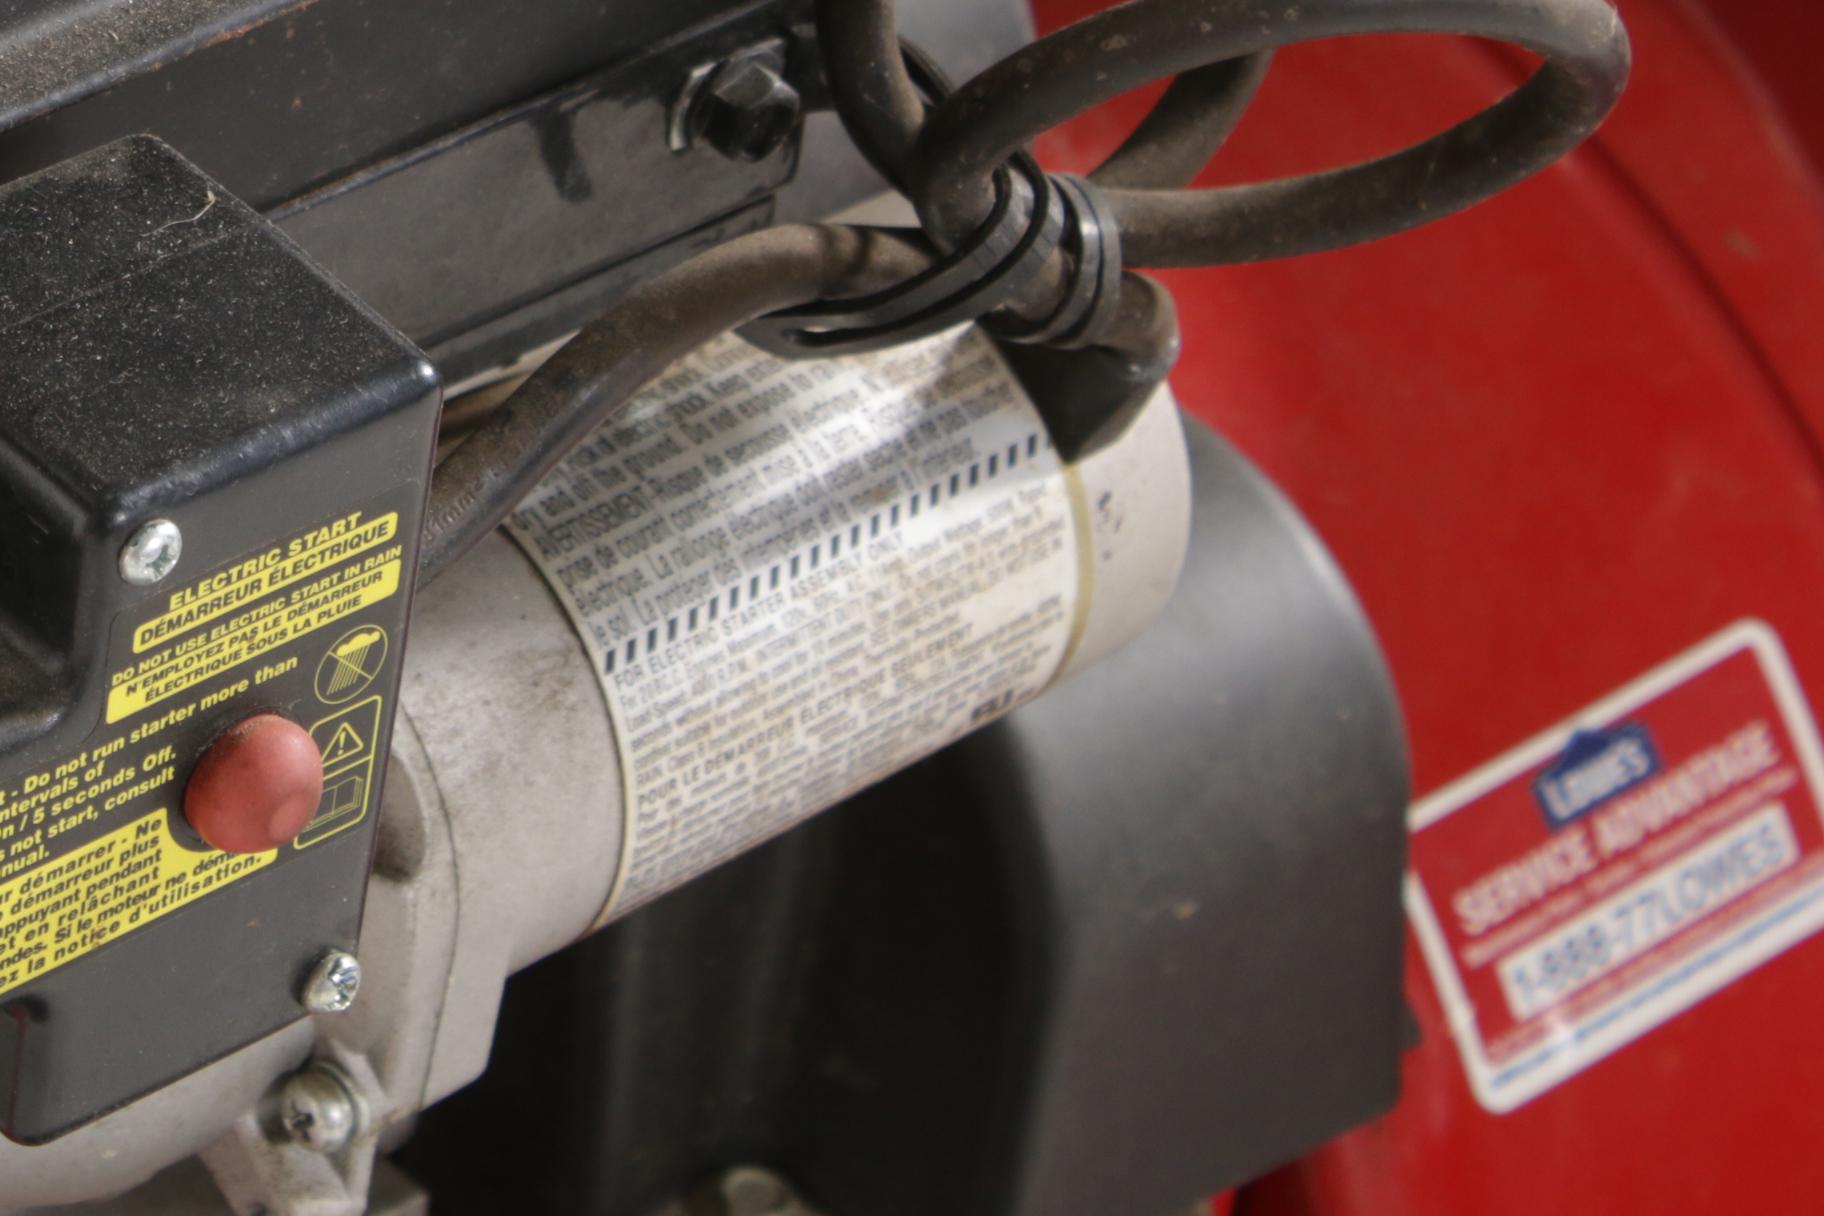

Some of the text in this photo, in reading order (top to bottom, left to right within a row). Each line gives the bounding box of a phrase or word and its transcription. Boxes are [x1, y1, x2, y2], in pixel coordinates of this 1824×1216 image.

[139, 517, 389, 646] DÉMARREUR ÉLECTRIQUE
[168, 510, 359, 611] ELECTRIC START
[111, 543, 402, 687] DO NOT USE ELECTRIC START IN RAIN
[125, 567, 383, 697] N'EMPLOYEZ PAS LE DÉMARREUR
[144, 593, 362, 703] ÉLECTRIQUE SOUS LA PLUIE
[647, 626, 720, 676] ELECTRIC
[720, 591, 787, 638] STARTER
[787, 550, 866, 604] ASSEMBLY
[23, 767, 50, 795] Do
[55, 750, 88, 781] not
[92, 734, 125, 762] run
[129, 699, 196, 745] starter
[200, 676, 249, 712] more
[254, 651, 298, 686] than
[83, 758, 106, 784] of
[10, 828, 42, 857] not
[46, 800, 100, 842] start,
[104, 763, 175, 812] consult
[32, 805, 46, 826] 5
[50, 761, 136, 817] seconds
[141, 742, 177, 773] Off.
[10, 852, 115, 917] démarreur
[119, 831, 160, 868] plus
[19, 834, 116, 896] démarrer
[134, 813, 162, 840] Ne
[85, 846, 162, 901] pendant
[24, 919, 50, 943] en
[57, 864, 159, 928] relâchant
[27, 952, 45, 975] la
[53, 916, 120, 963] notice
[127, 845, 263, 928] d'utilisation.
[53, 924, 72, 945] Si
[76, 913, 93, 934] le
[97, 880, 160, 924] moteur
[164, 869, 187, 890] ne
